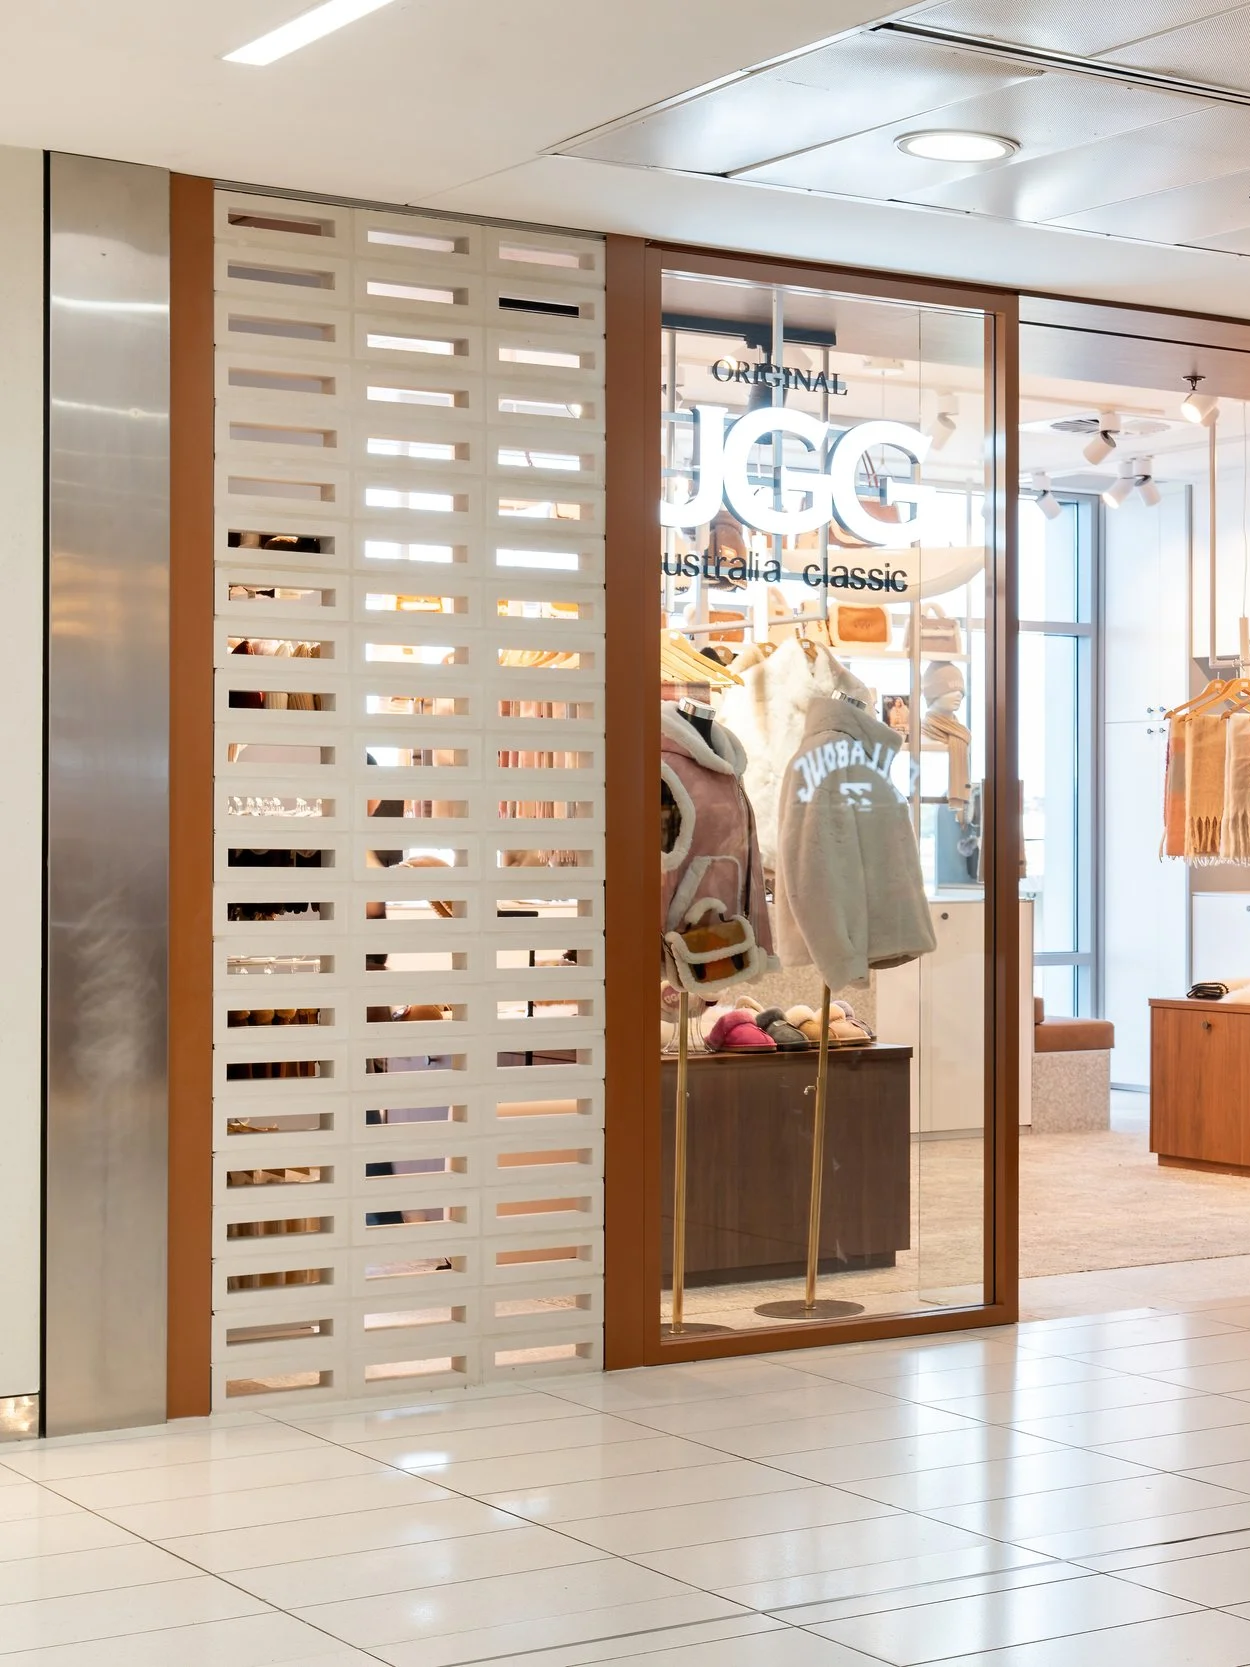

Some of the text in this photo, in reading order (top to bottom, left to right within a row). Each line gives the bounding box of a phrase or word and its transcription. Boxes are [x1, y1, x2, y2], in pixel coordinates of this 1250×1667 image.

[711, 358, 849, 396] ORIGINAL
[660, 548, 909, 593] ustralia classic
